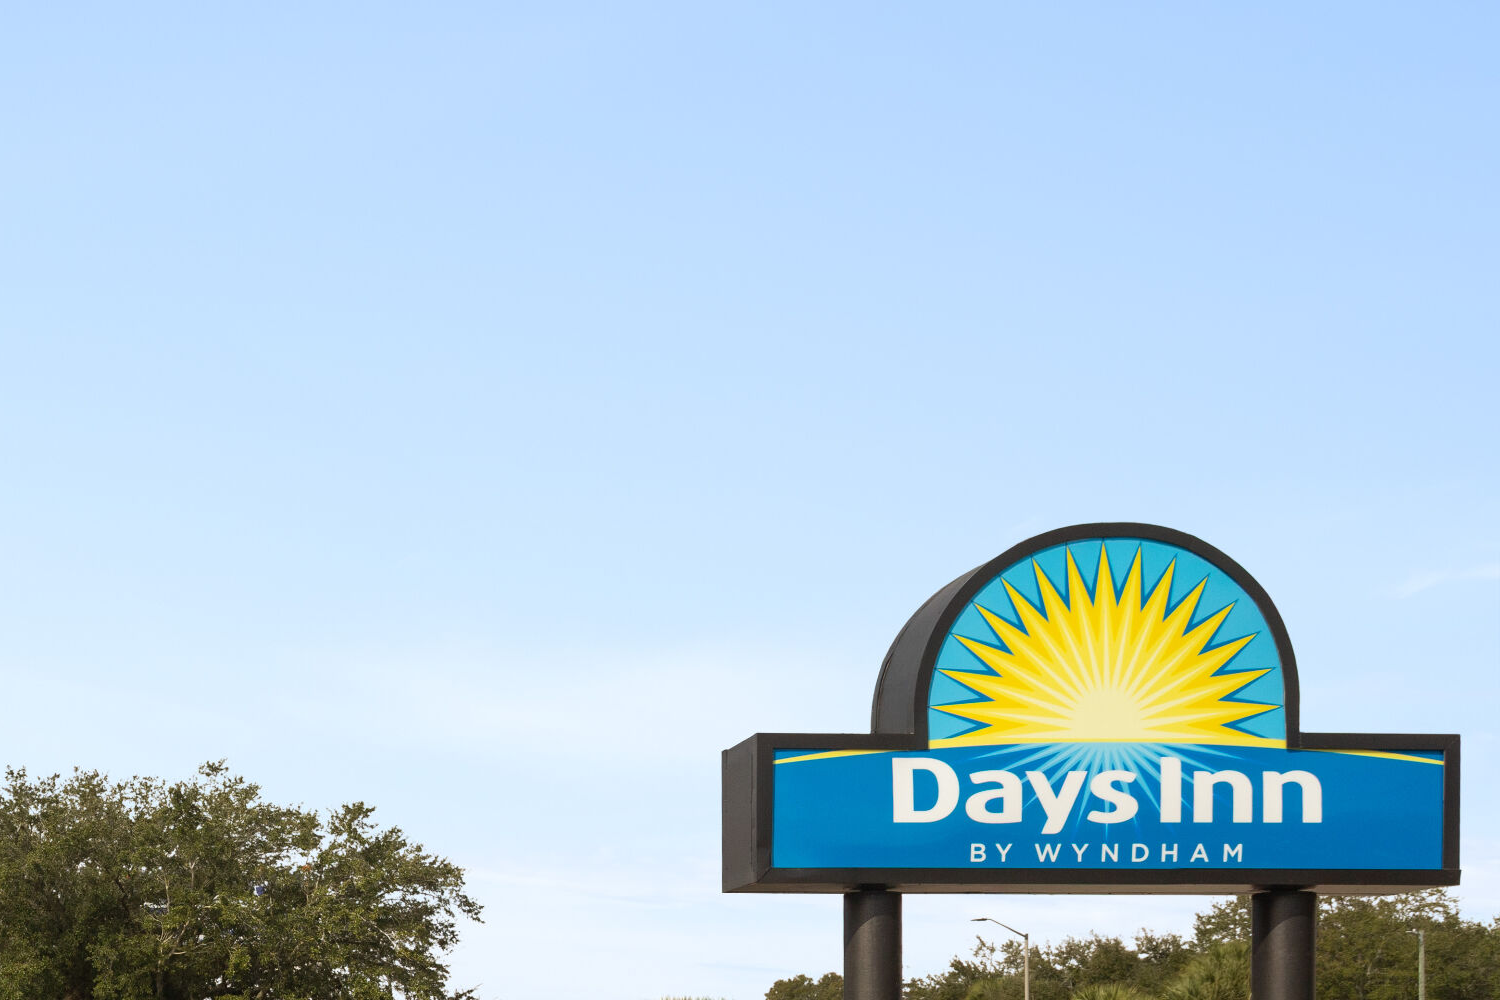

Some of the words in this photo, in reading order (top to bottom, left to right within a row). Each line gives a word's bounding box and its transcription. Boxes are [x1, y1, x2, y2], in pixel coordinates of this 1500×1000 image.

[891, 757, 1139, 835] Days
[1159, 756, 1323, 823] Inn
[970, 843, 1013, 863] BY
[1035, 843, 1246, 863] WYNDHAM
